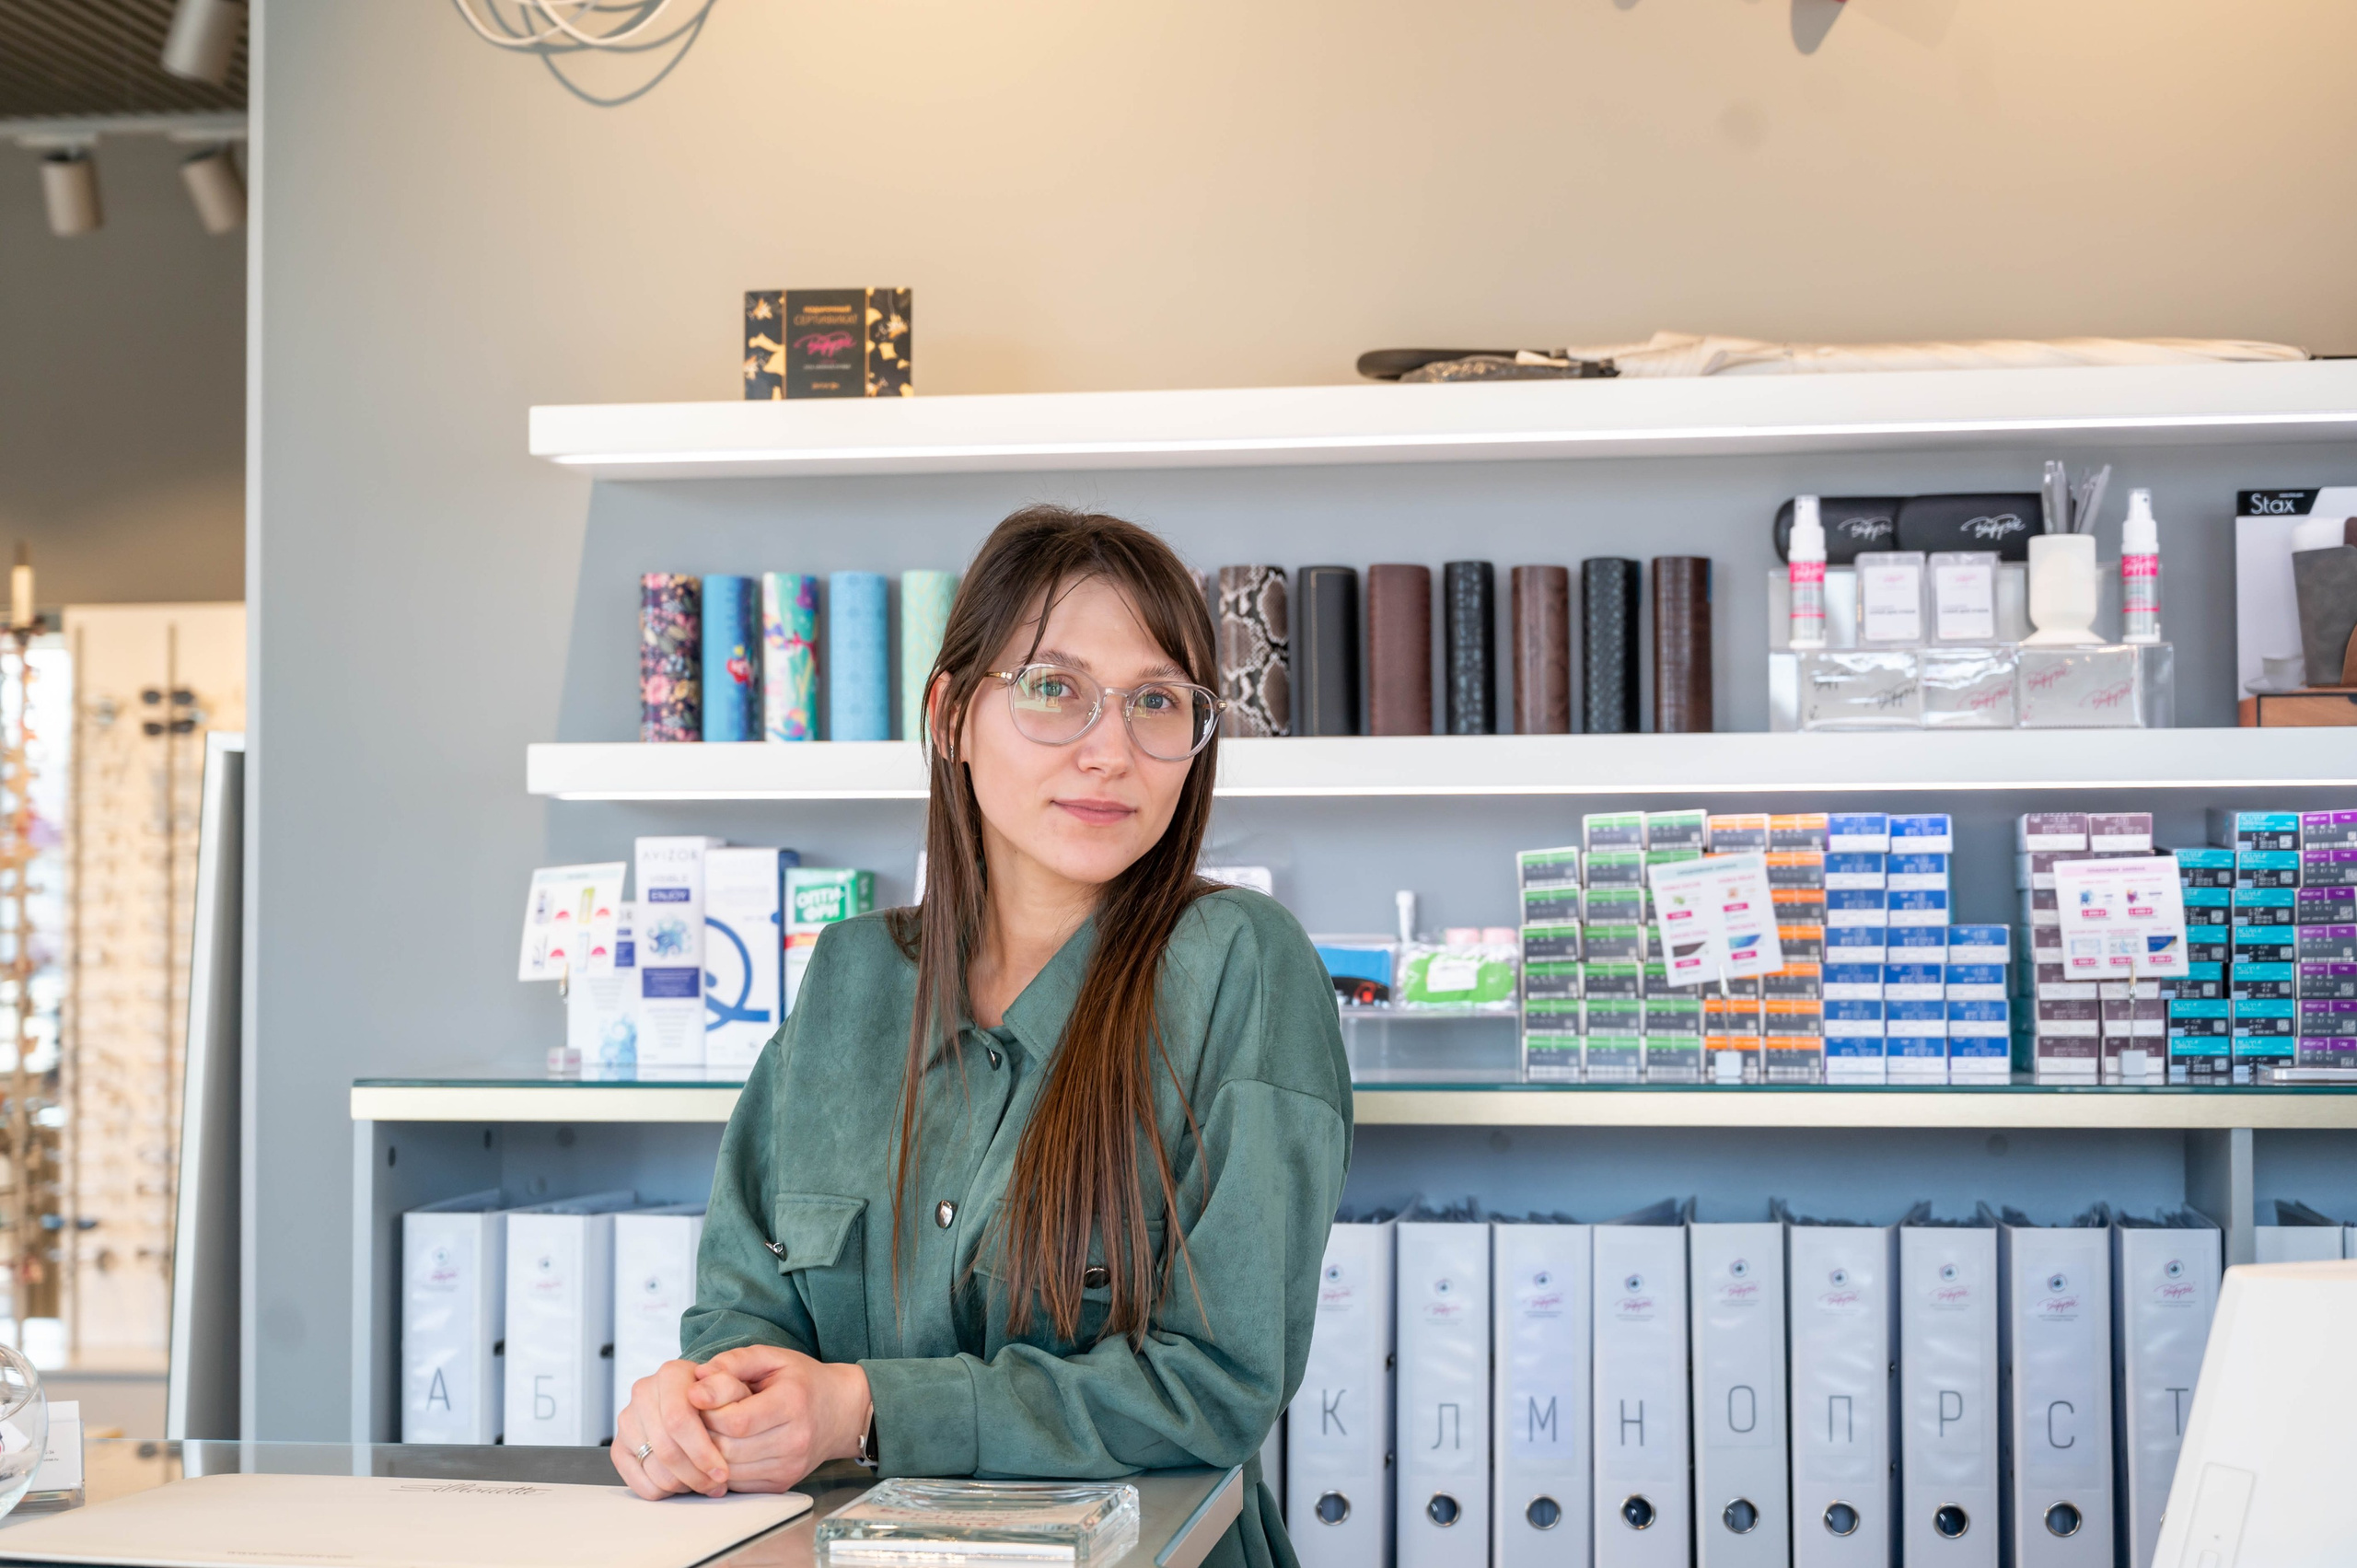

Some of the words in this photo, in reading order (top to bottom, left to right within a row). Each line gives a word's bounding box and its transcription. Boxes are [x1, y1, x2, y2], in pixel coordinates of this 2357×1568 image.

[2250, 493, 2296, 515] Stax
[426, 1366, 451, 1411] А
[534, 1375, 556, 1420] Б
[1321, 1388, 1348, 1436] К
[1727, 1385, 1757, 1434] О
[2165, 1387, 2189, 1436] Т
[1431, 1402, 1461, 1449] Л
[1527, 1395, 1558, 1443] М
[1620, 1399, 1644, 1446] Н
[1828, 1395, 1852, 1443] П
[1938, 1389, 1963, 1438] Р
[2047, 1400, 2075, 1449] С
[389, 1483, 553, 1496] Silhouette
